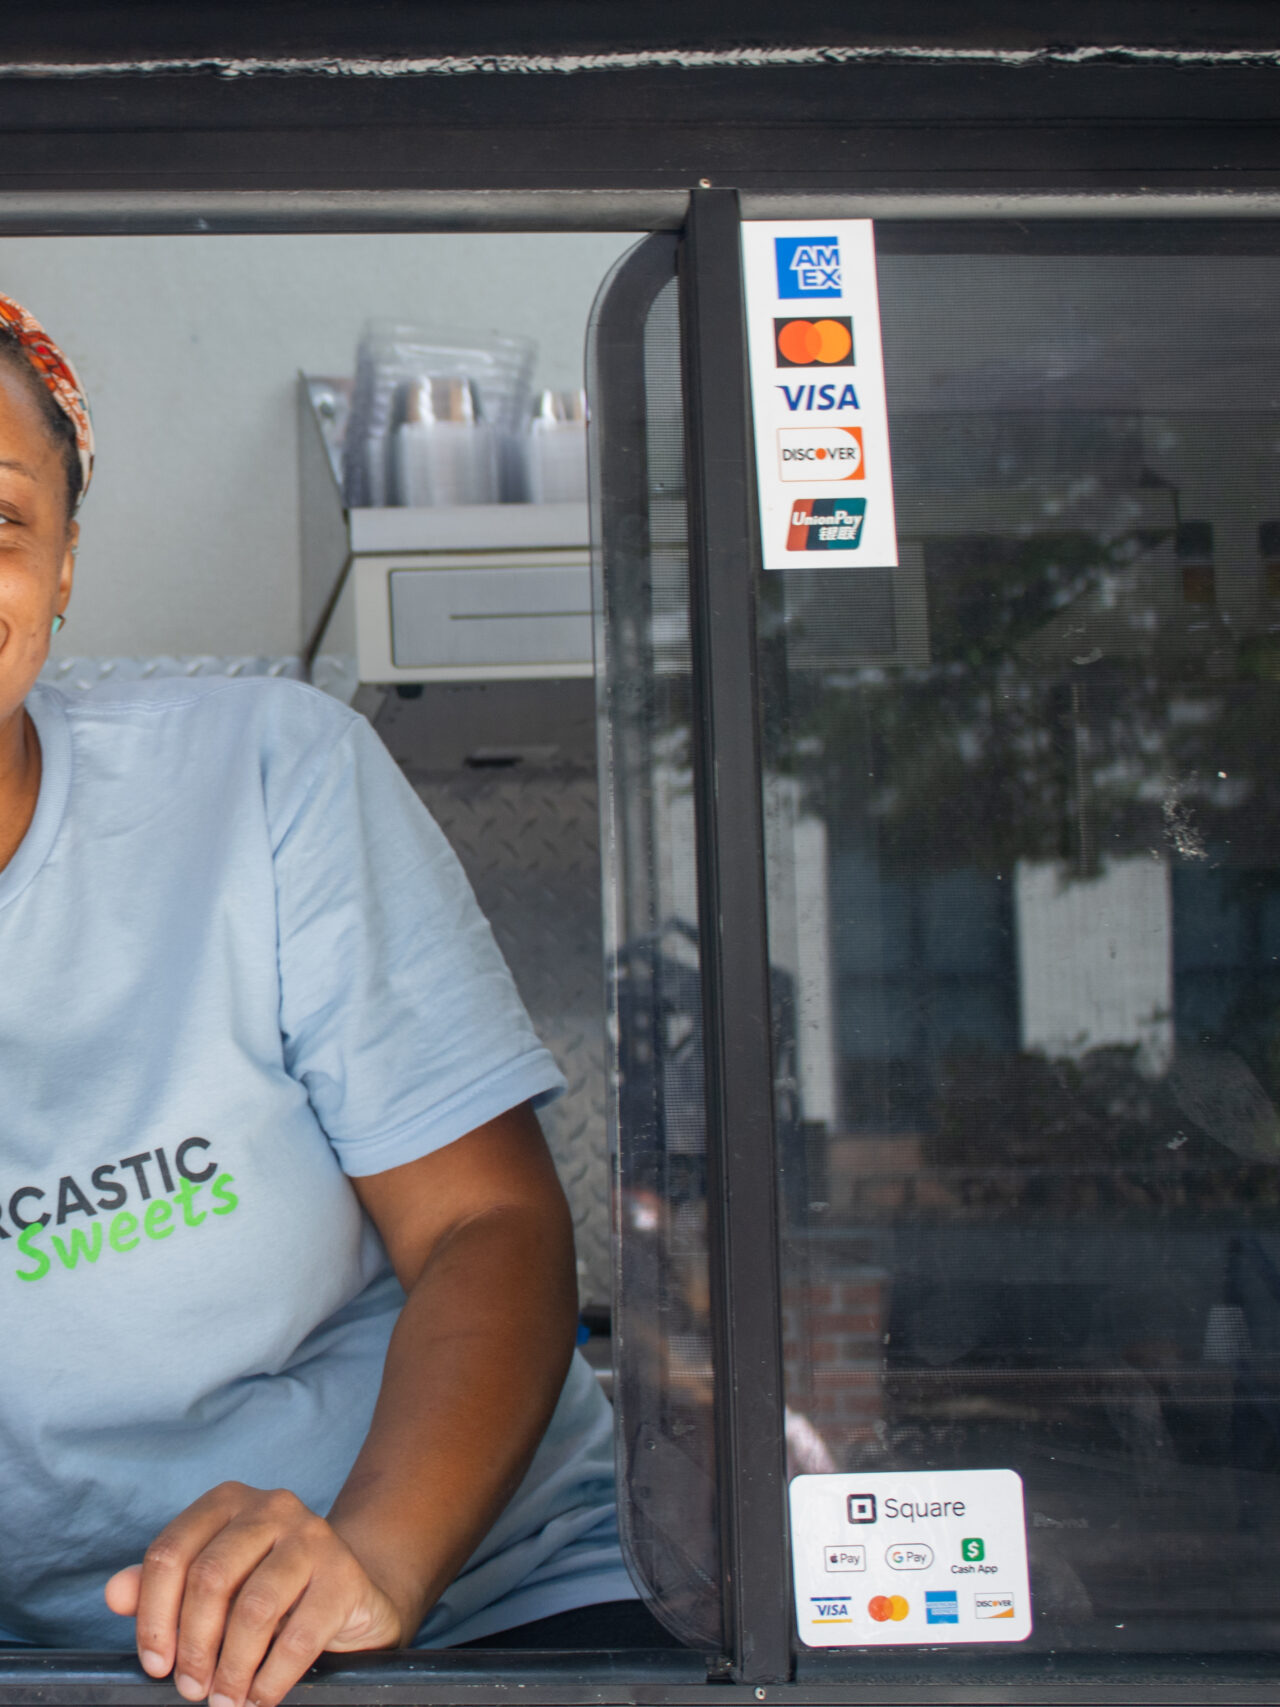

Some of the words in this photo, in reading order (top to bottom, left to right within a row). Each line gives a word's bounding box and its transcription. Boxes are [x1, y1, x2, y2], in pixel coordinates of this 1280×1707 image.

[791, 246, 840, 269] AM
[800, 268, 841, 289] EX
[775, 384, 860, 411] VISA
[782, 447, 856, 461] DISCOVER
[792, 510, 863, 528] UnionPay
[15, 1173, 239, 1282] Sweets
[884, 1498, 966, 1522] Square
[840, 1552, 860, 1566] Pay
[892, 1551, 904, 1563] G
[906, 1551, 927, 1565] Pay
[951, 1565, 975, 1574] Cash
[978, 1564, 998, 1575] App
[816, 1604, 848, 1616] VISA
[976, 1599, 1012, 1608] DISCOVER
